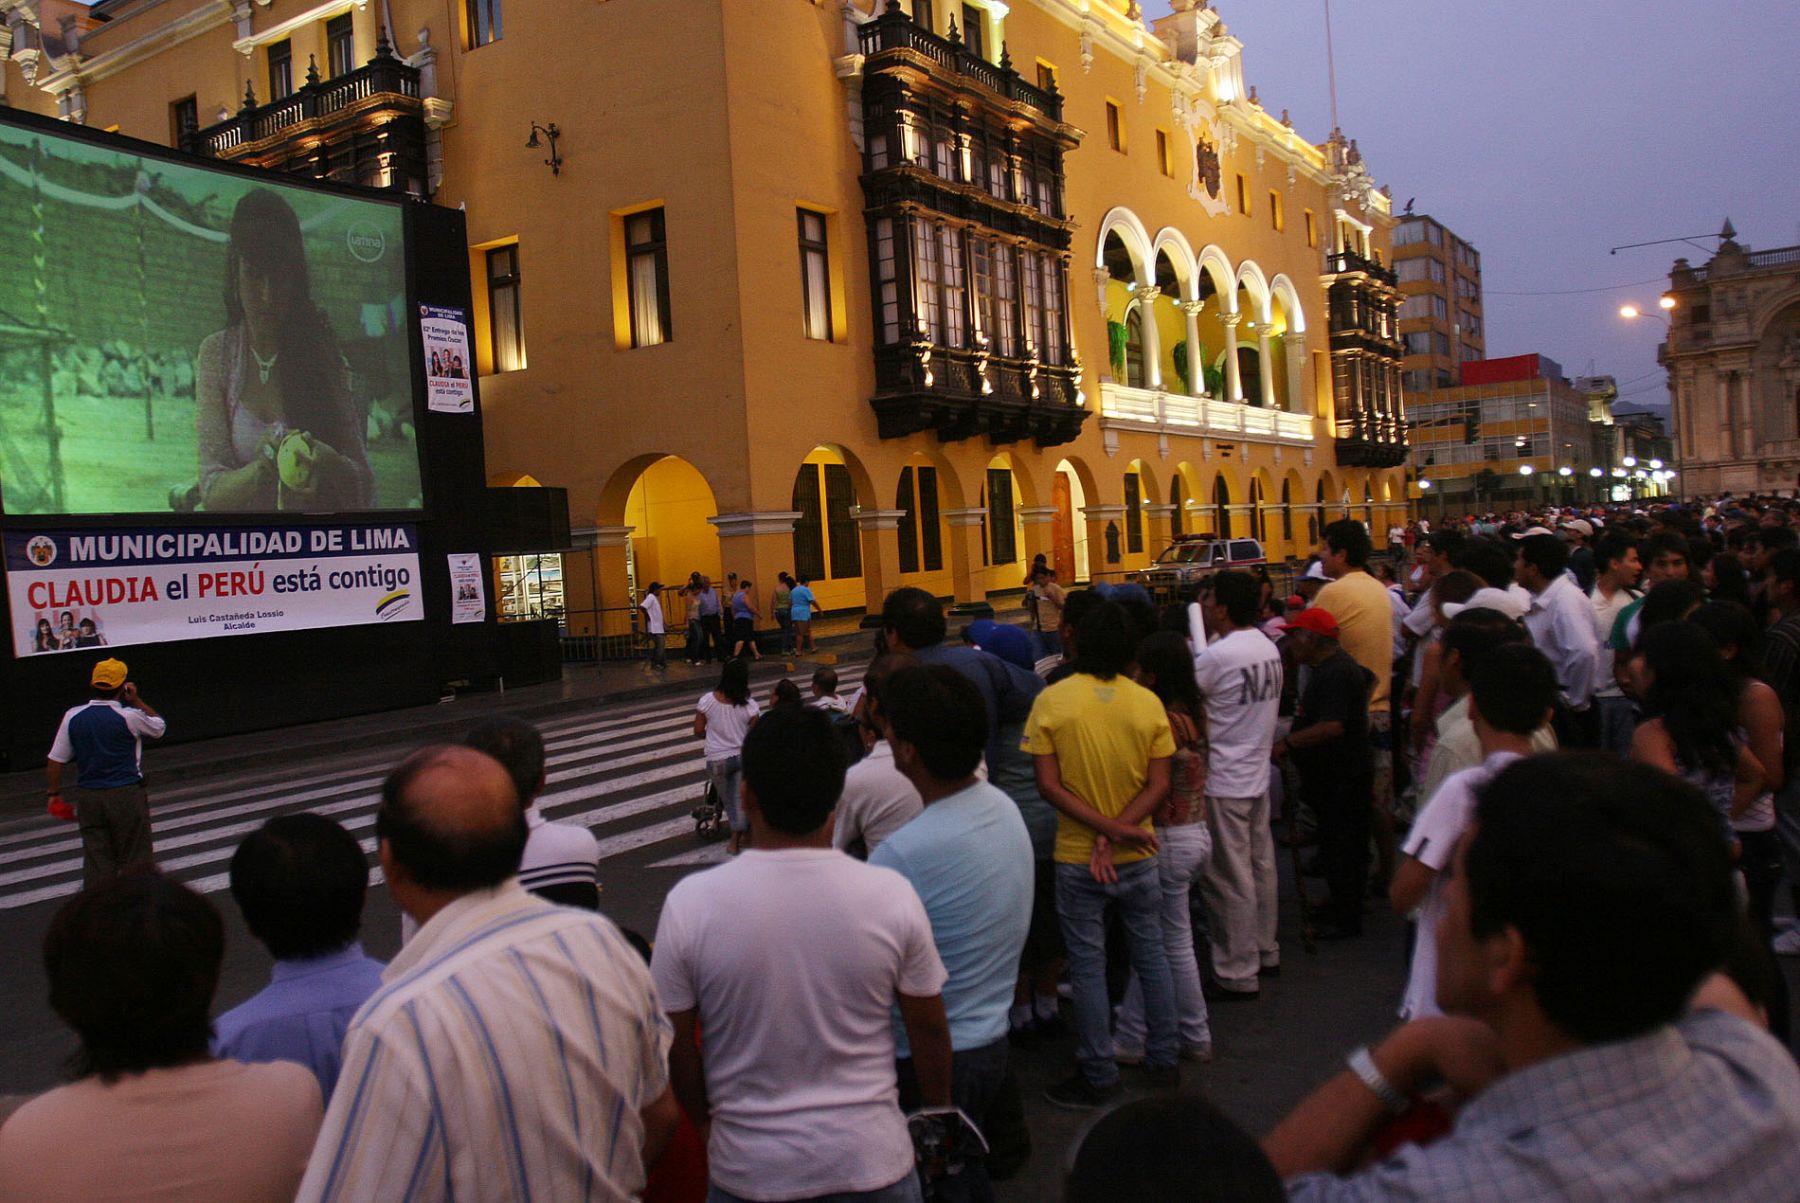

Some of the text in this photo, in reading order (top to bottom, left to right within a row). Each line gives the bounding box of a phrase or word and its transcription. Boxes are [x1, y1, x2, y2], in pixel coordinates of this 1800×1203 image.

[69, 528, 410, 562] MUNICIPALIDAD DE LIMA
[28, 562, 410, 609] CLAUDIA el PERÚ está contigo
[188, 609, 284, 624] Luis Castañeda Lossio
[223, 621, 256, 631] Alcalde
